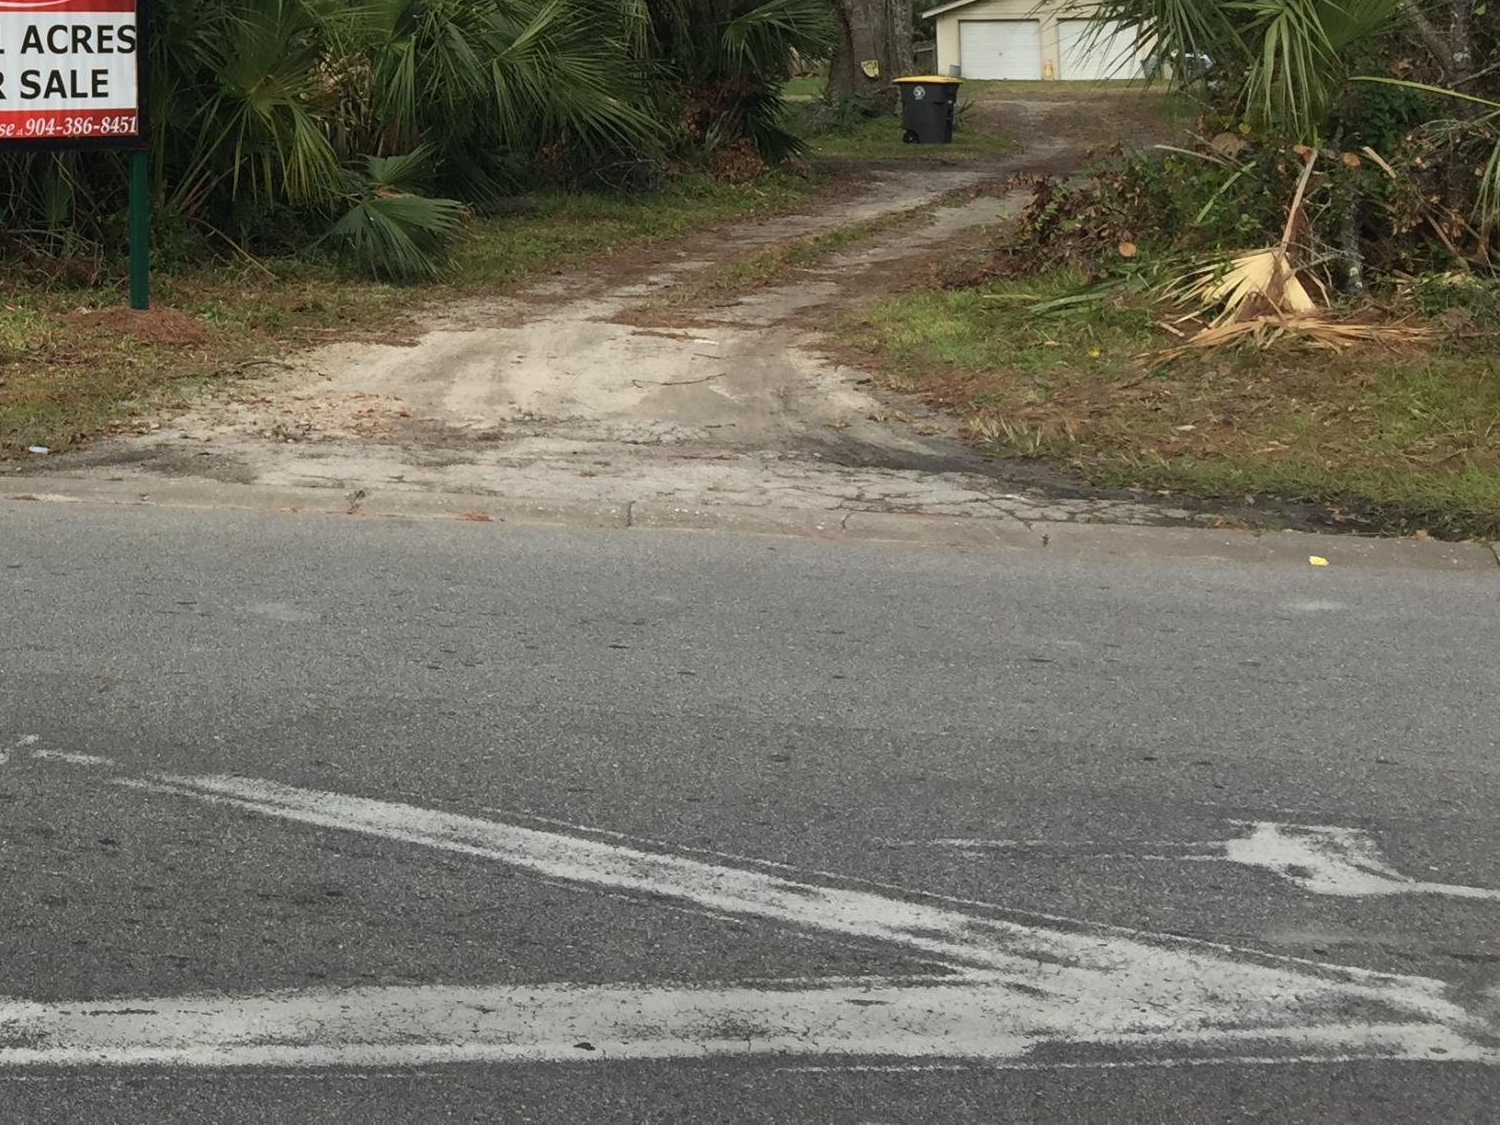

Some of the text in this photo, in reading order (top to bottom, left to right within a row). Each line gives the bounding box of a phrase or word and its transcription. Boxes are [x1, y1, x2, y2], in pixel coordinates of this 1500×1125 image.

[20, 24, 137, 55] ACRES
[19, 68, 109, 99] SALE
[24, 115, 137, 136] 904-386-8451
